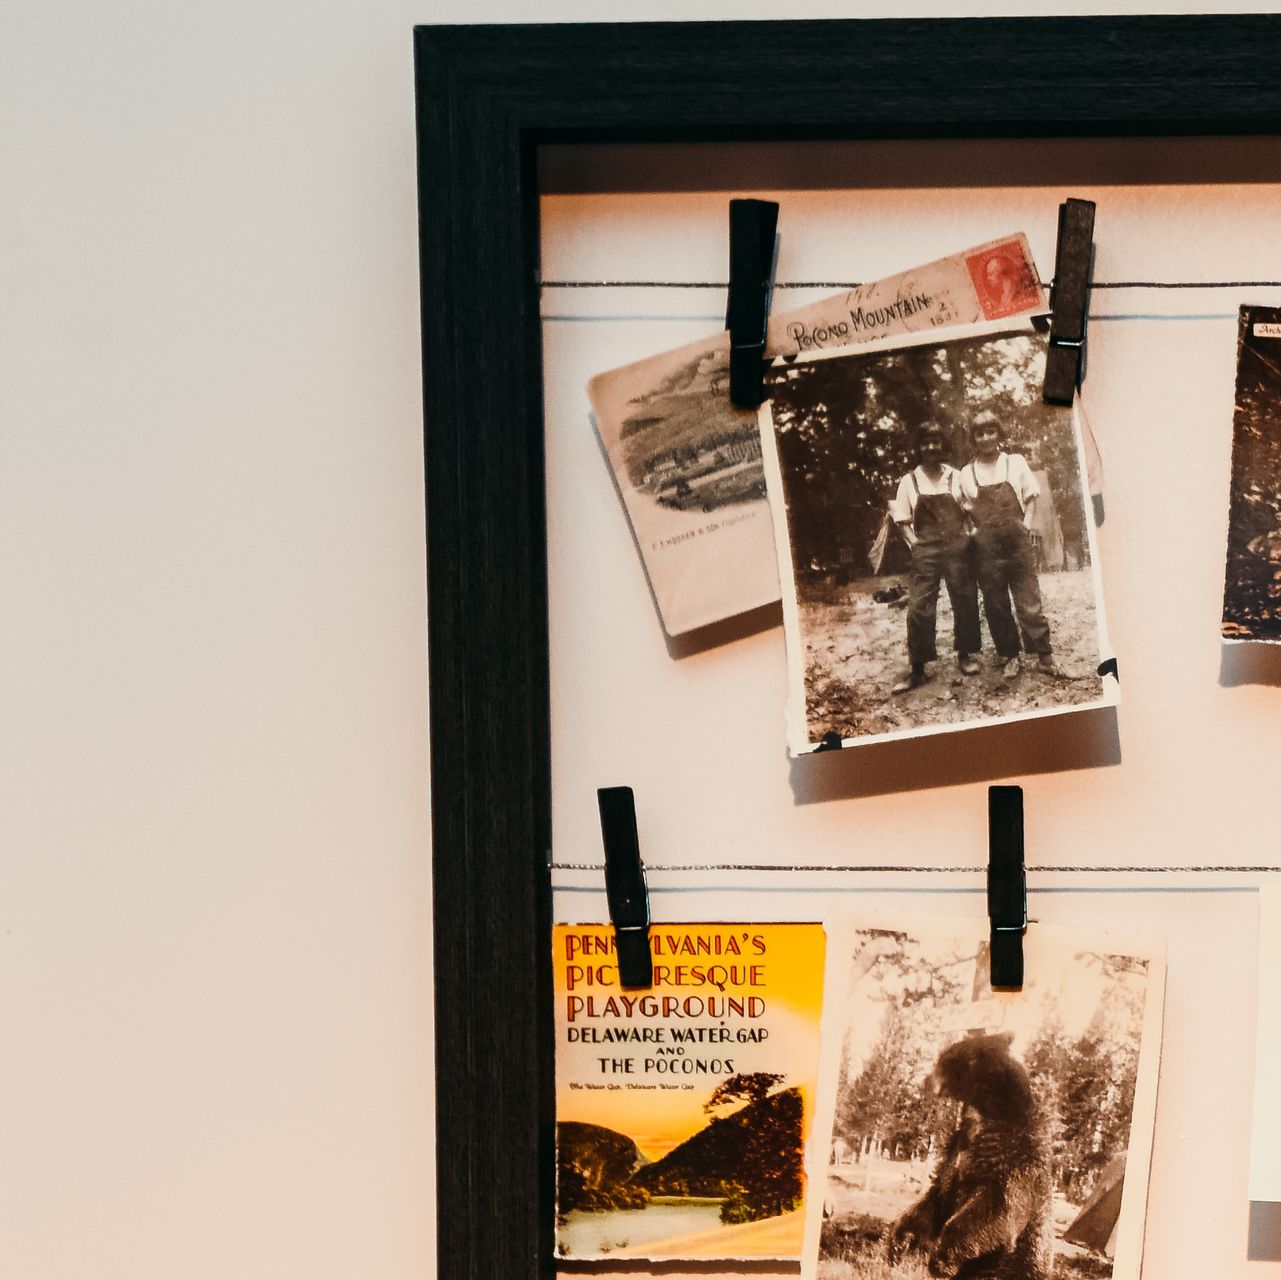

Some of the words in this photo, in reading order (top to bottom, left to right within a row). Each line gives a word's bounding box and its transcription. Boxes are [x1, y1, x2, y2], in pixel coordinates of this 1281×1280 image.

[850, 293, 929, 331] MOUNTAIN
[565, 933, 766, 961] PENLVANIA'S
[566, 965, 766, 992] PICRESQUE
[566, 995, 766, 1022] PLAYGROUND
[567, 1027, 665, 1043] DELAWARE
[670, 1027, 736, 1043] WATER
[736, 1028, 769, 1043] GAP
[655, 1047, 686, 1055] AND
[597, 1058, 635, 1073] THE
[644, 1058, 735, 1074] POCONOS
